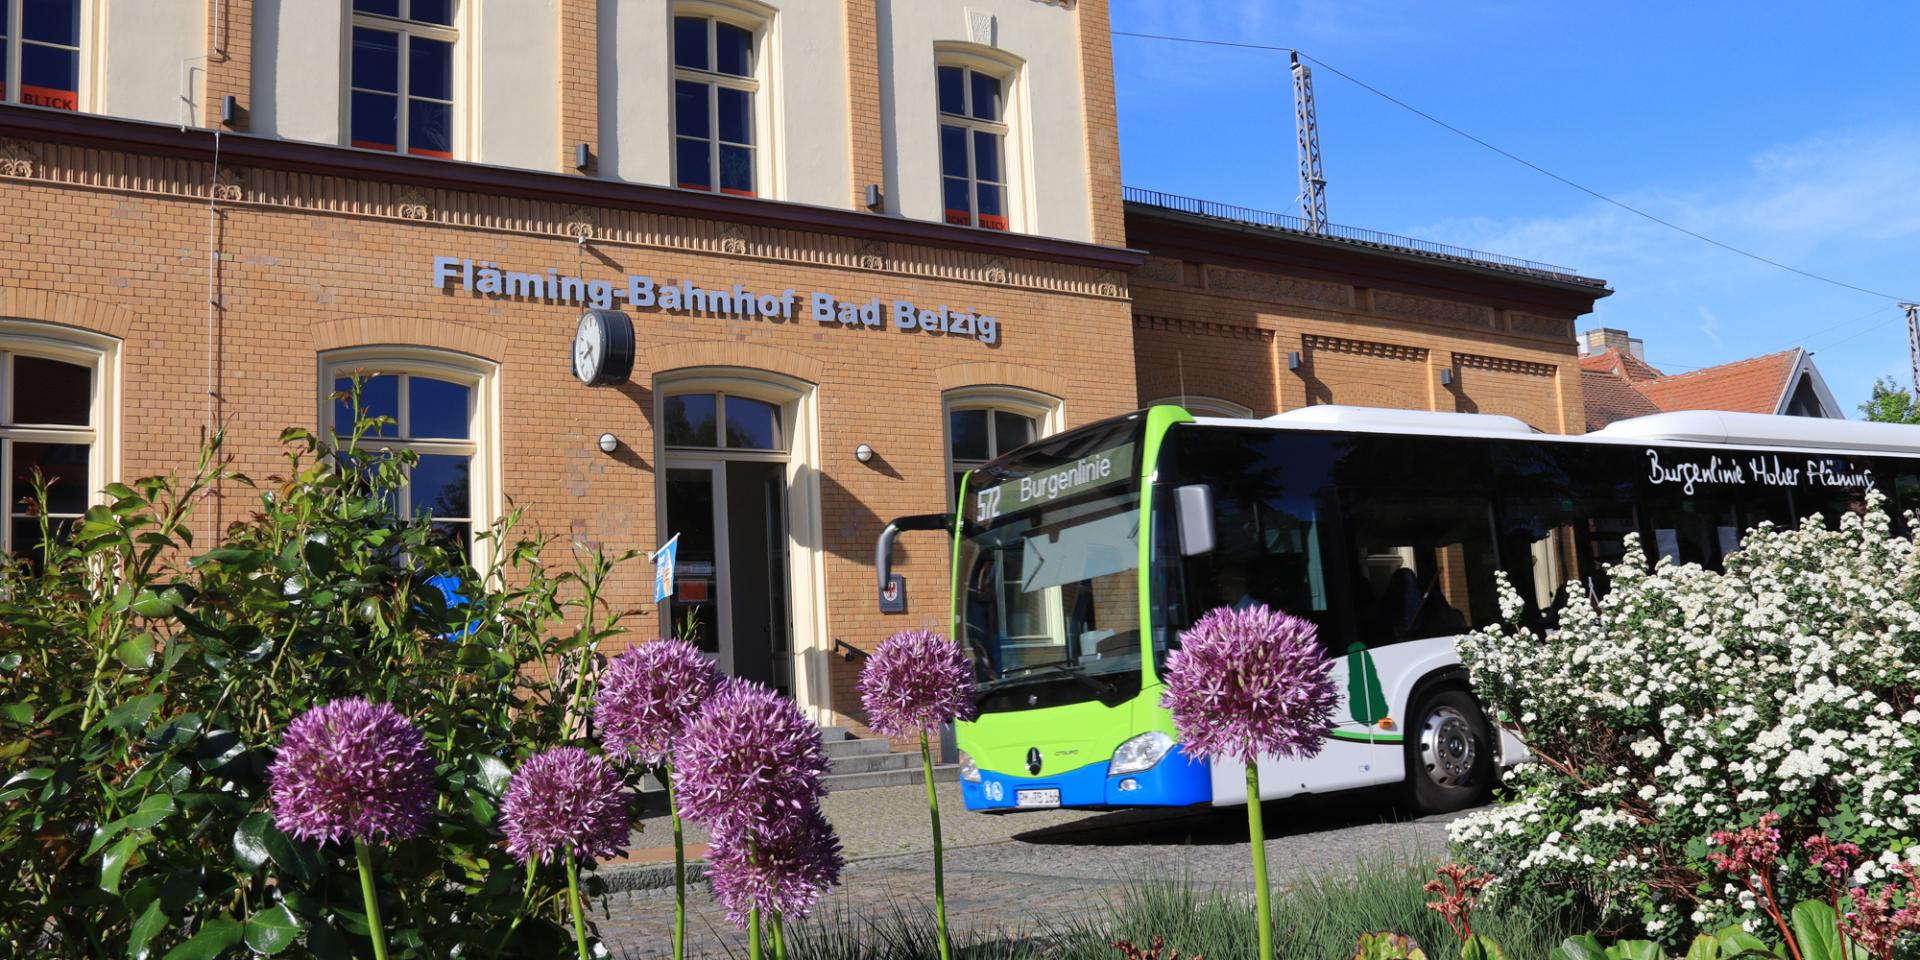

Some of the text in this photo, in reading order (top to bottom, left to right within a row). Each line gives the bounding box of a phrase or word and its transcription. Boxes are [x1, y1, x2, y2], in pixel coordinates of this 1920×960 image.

[23, 93, 73, 111] BLICK
[979, 219, 1006, 231] BLICK
[433, 255, 998, 344] Fläming-Bahnhof Bad Belzig
[976, 455, 1111, 522] 572 Burgenlinie
[1646, 449, 1874, 496] Burgenlinie Hoher Fläming
